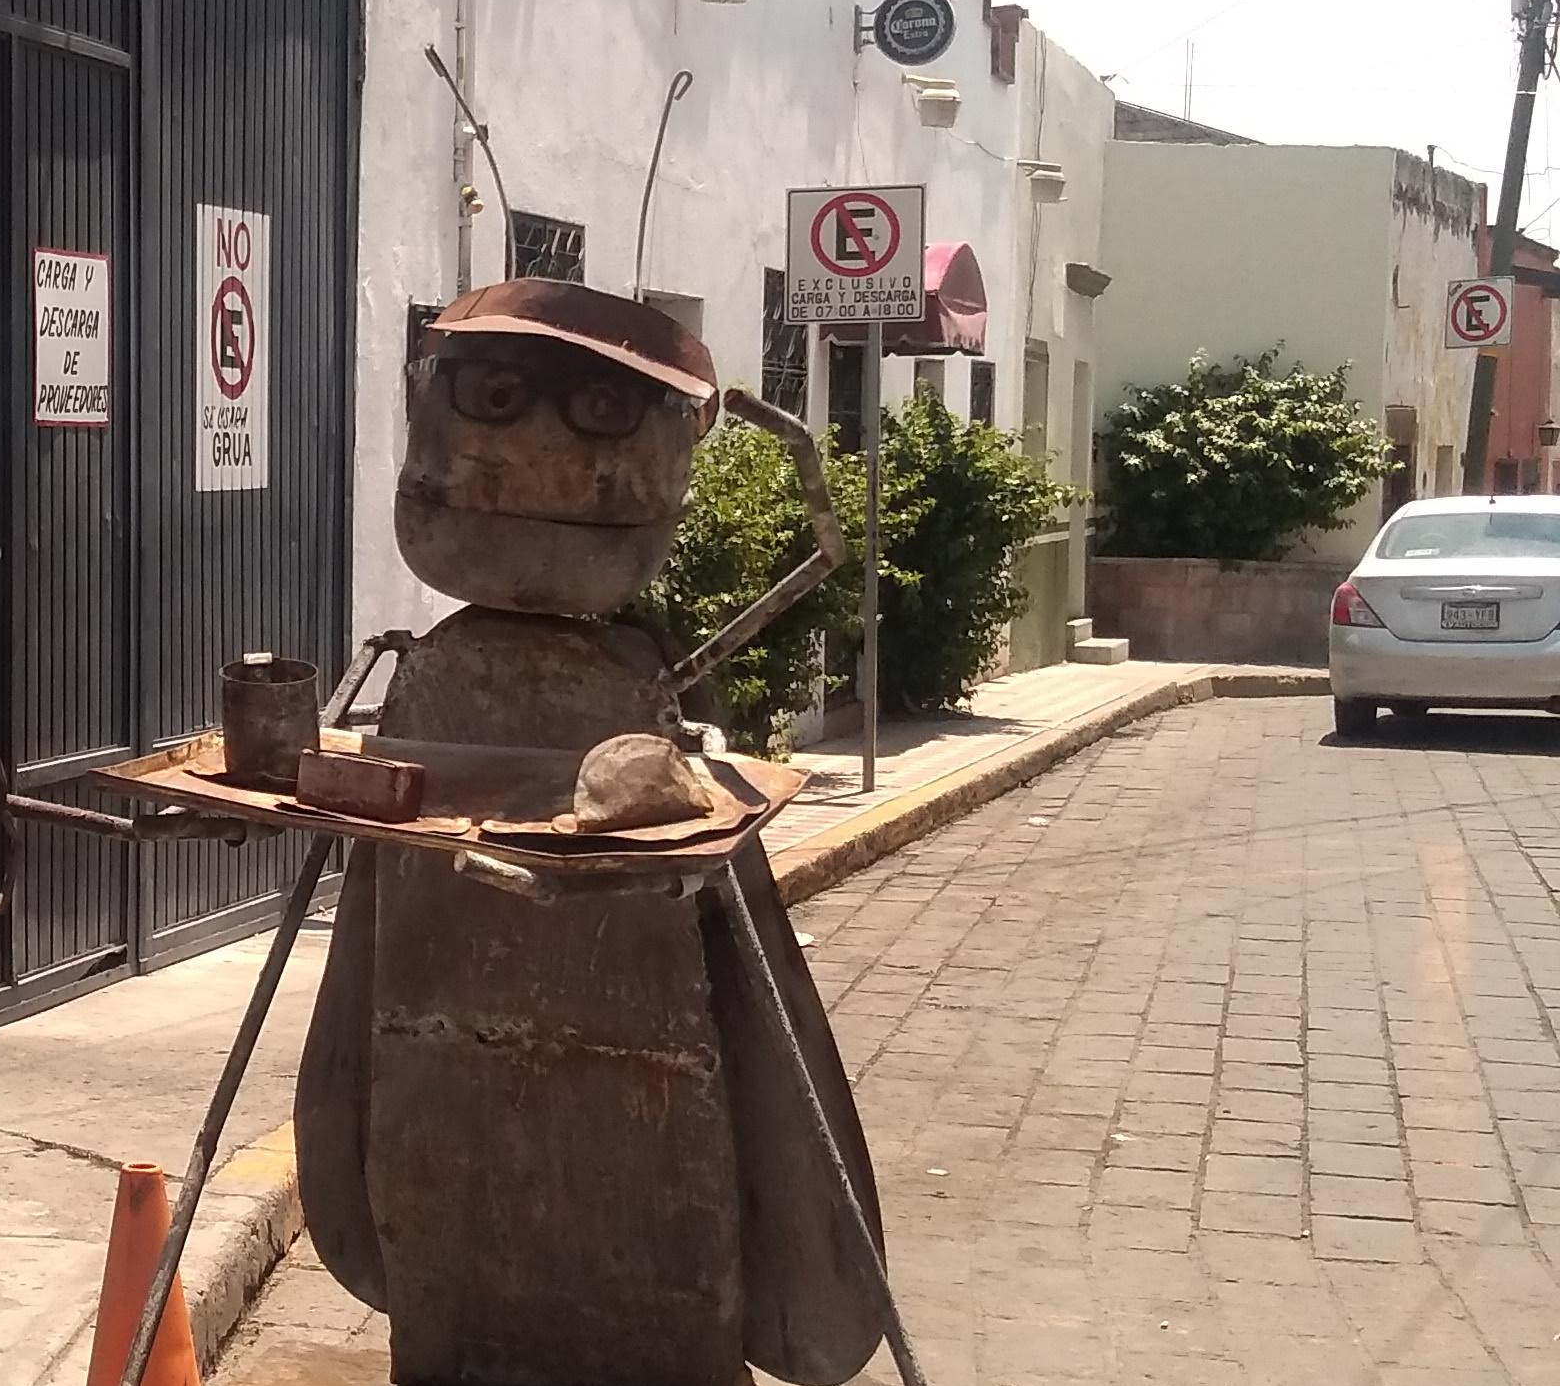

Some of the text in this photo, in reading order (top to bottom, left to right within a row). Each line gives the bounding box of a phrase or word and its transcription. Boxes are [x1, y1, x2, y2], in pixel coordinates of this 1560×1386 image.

[891, 17, 937, 34] Corona
[903, 29, 929, 40] Extra
[216, 217, 251, 271] NO
[37, 258, 95, 292] CARGA Y
[797, 276, 912, 292] EXCLUSIVO
[791, 290, 917, 305] CARGA Y DESCARGA
[40, 306, 100, 340] DESCARGA
[791, 306, 809, 319] DE
[862, 303, 871, 317] A
[63, 350, 81, 376] DE
[37, 383, 109, 415] PROVEEDORES
[212, 431, 253, 468] GRUA
